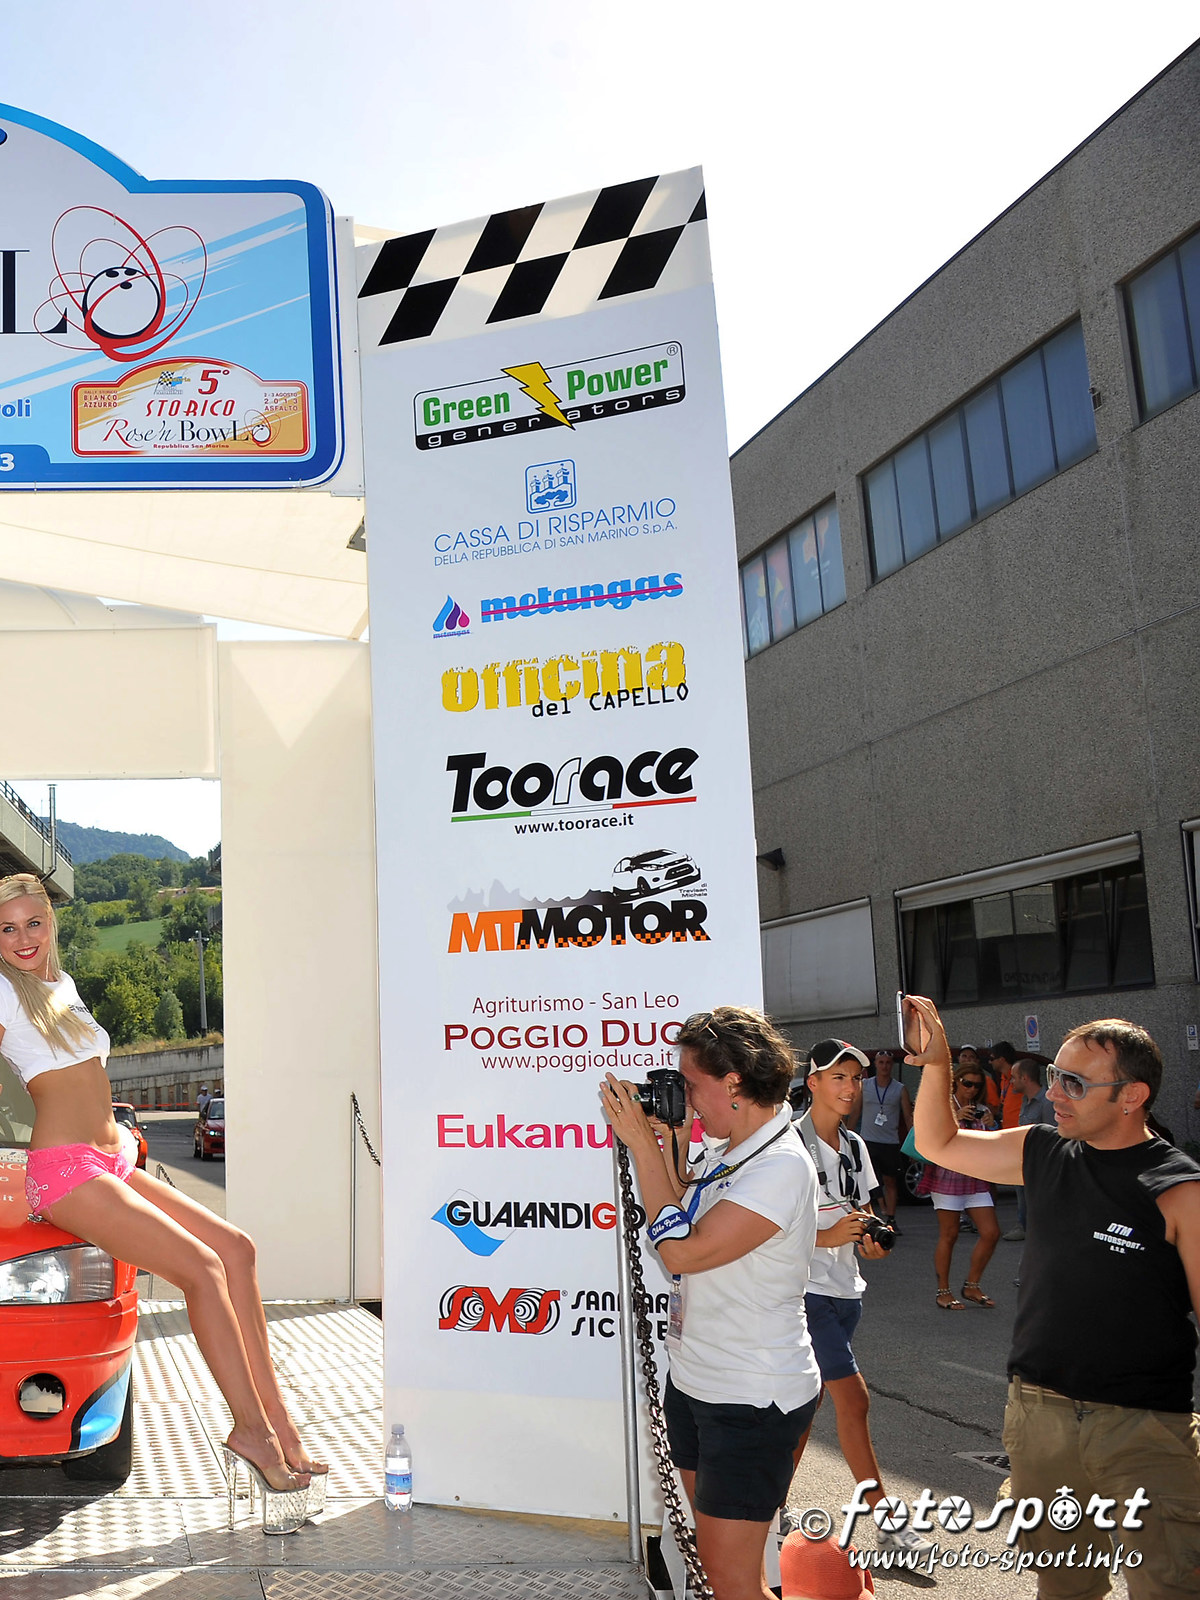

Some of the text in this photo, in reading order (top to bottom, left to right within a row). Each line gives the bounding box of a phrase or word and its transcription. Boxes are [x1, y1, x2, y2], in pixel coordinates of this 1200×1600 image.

[198, 369, 230, 395] 5°
[422, 357, 669, 428] Green Power
[145, 400, 236, 417] STORICO
[427, 389, 681, 448] generators
[434, 498, 677, 553] CASSA DI RISPARMIO
[434, 520, 679, 568] DELLA REPUBBLICA DI SAN MARINO S.p.A.
[480, 572, 684, 624] metangas
[441, 640, 687, 713] officina
[531, 682, 690, 718] del CAPELLO
[445, 747, 700, 814] Toorace
[513, 813, 635, 835] www.toorace.it
[472, 995, 584, 1018] Agriturismo
[602, 992, 638, 1011] San
[644, 991, 680, 1009] Leo
[481, 1049, 674, 1073] www.poggioduca.it
[436, 1114, 613, 1149] Eukanu
[1107, 1222, 1134, 1238] DTM
